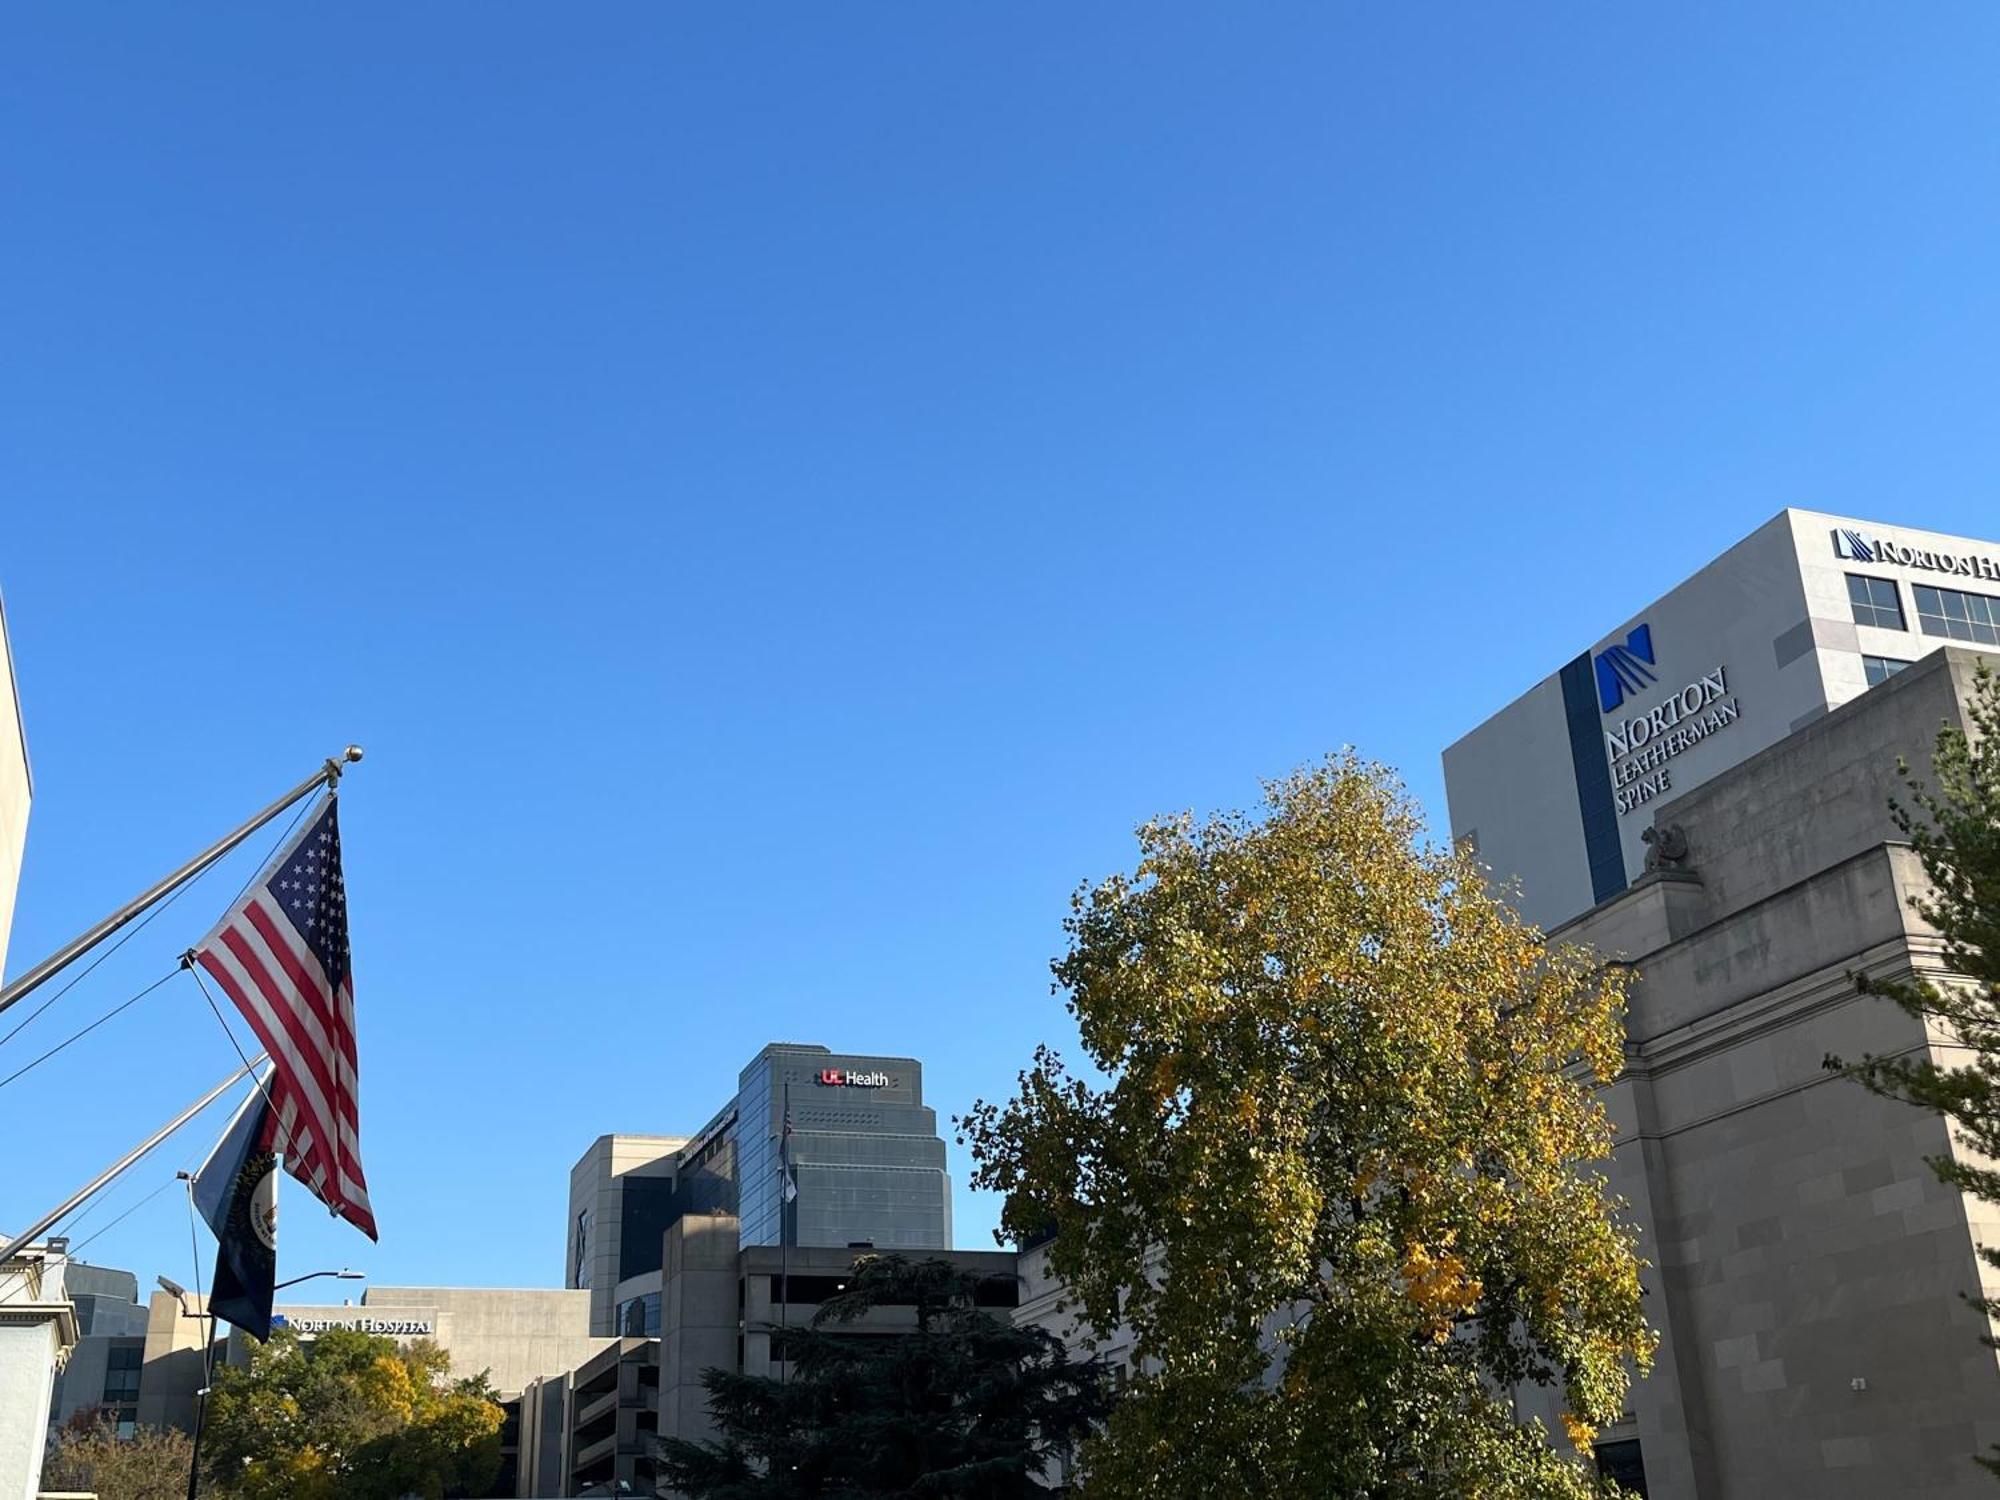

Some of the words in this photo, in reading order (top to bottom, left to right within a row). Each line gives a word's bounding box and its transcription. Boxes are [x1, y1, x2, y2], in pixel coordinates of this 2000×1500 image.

[1876, 539, 1970, 576] NORTON
[1604, 665, 1728, 765] NORTON
[1612, 698, 1741, 789] LEATHERMAN
[1616, 768, 1672, 816] SPINE
[845, 1070, 889, 1087] Health
[288, 1317, 357, 1332] NORTON
